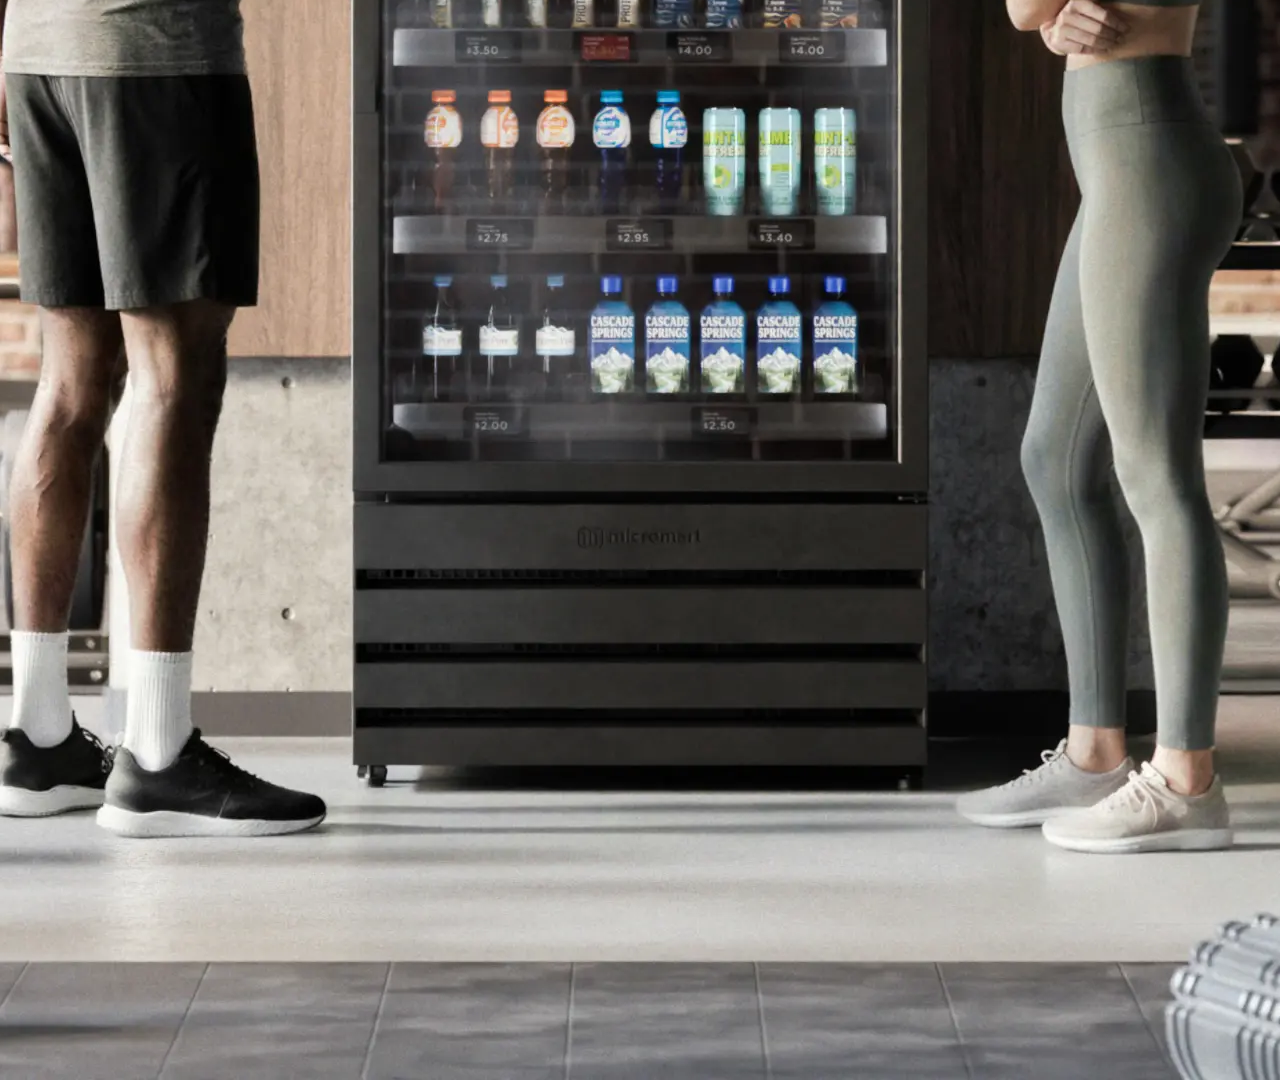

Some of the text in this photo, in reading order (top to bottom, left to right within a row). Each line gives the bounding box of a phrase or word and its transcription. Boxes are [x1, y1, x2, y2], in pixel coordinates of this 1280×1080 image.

[466, 45, 499, 55] $3.50
[678, 45, 712, 55] $4.00
[791, 45, 824, 55] $4.00
[478, 233, 508, 243] $2.75
[618, 233, 649, 243] $2.95
[760, 233, 793, 243] $3.40
[591, 316, 634, 328] CASCADE
[646, 316, 689, 328] CASCADE
[700, 316, 744, 328] CASCADE
[757, 316, 800, 328] CASCADE
[813, 316, 857, 328] CASCADE
[592, 327, 633, 339] SPRINGS
[647, 327, 688, 339] SPRINGS
[701, 327, 743, 339] SPRINGS
[758, 327, 799, 339] SPRINGS
[814, 327, 856, 339] SPRINGS
[475, 421, 508, 431] $2.00
[704, 421, 735, 431] $2.50
